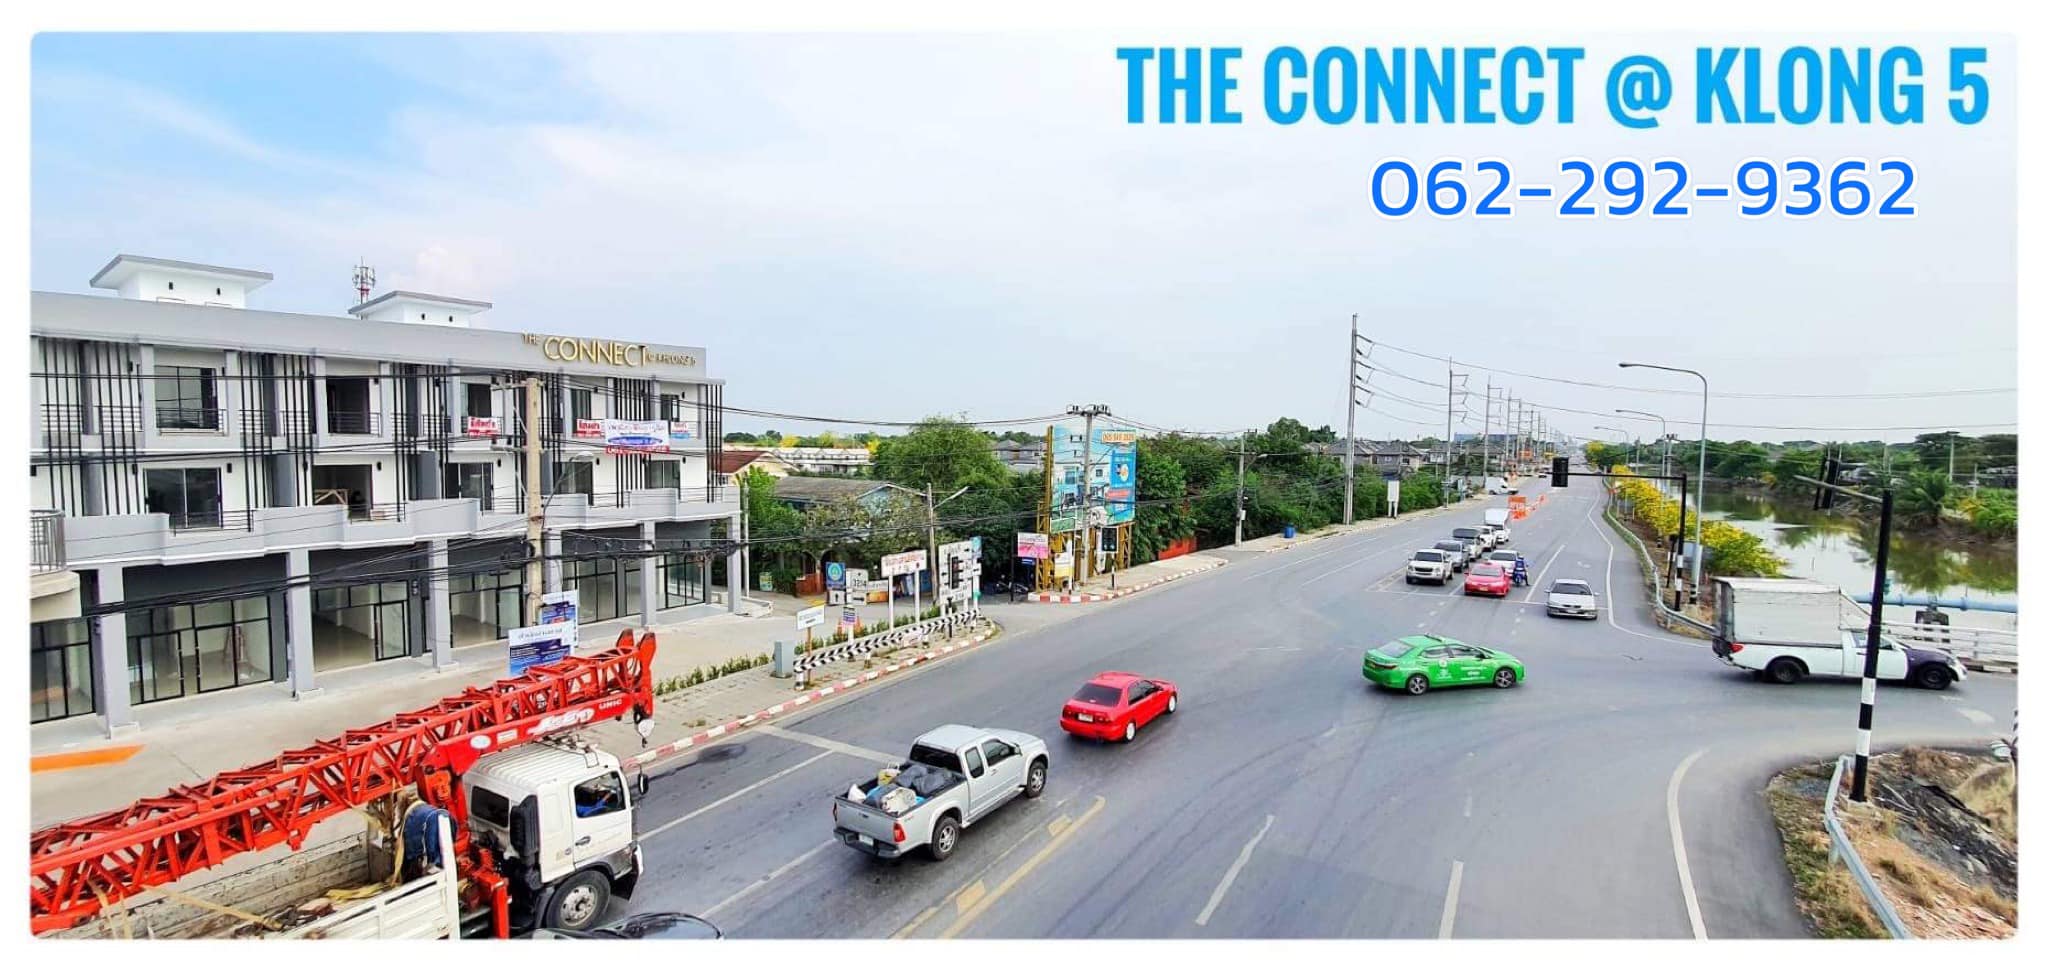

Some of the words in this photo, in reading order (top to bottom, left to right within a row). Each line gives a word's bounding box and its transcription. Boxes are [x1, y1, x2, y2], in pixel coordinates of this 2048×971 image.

[522, 331, 541, 346] THE
[544, 336, 648, 367] CONNECT
[599, 699, 622, 709] UNIC
